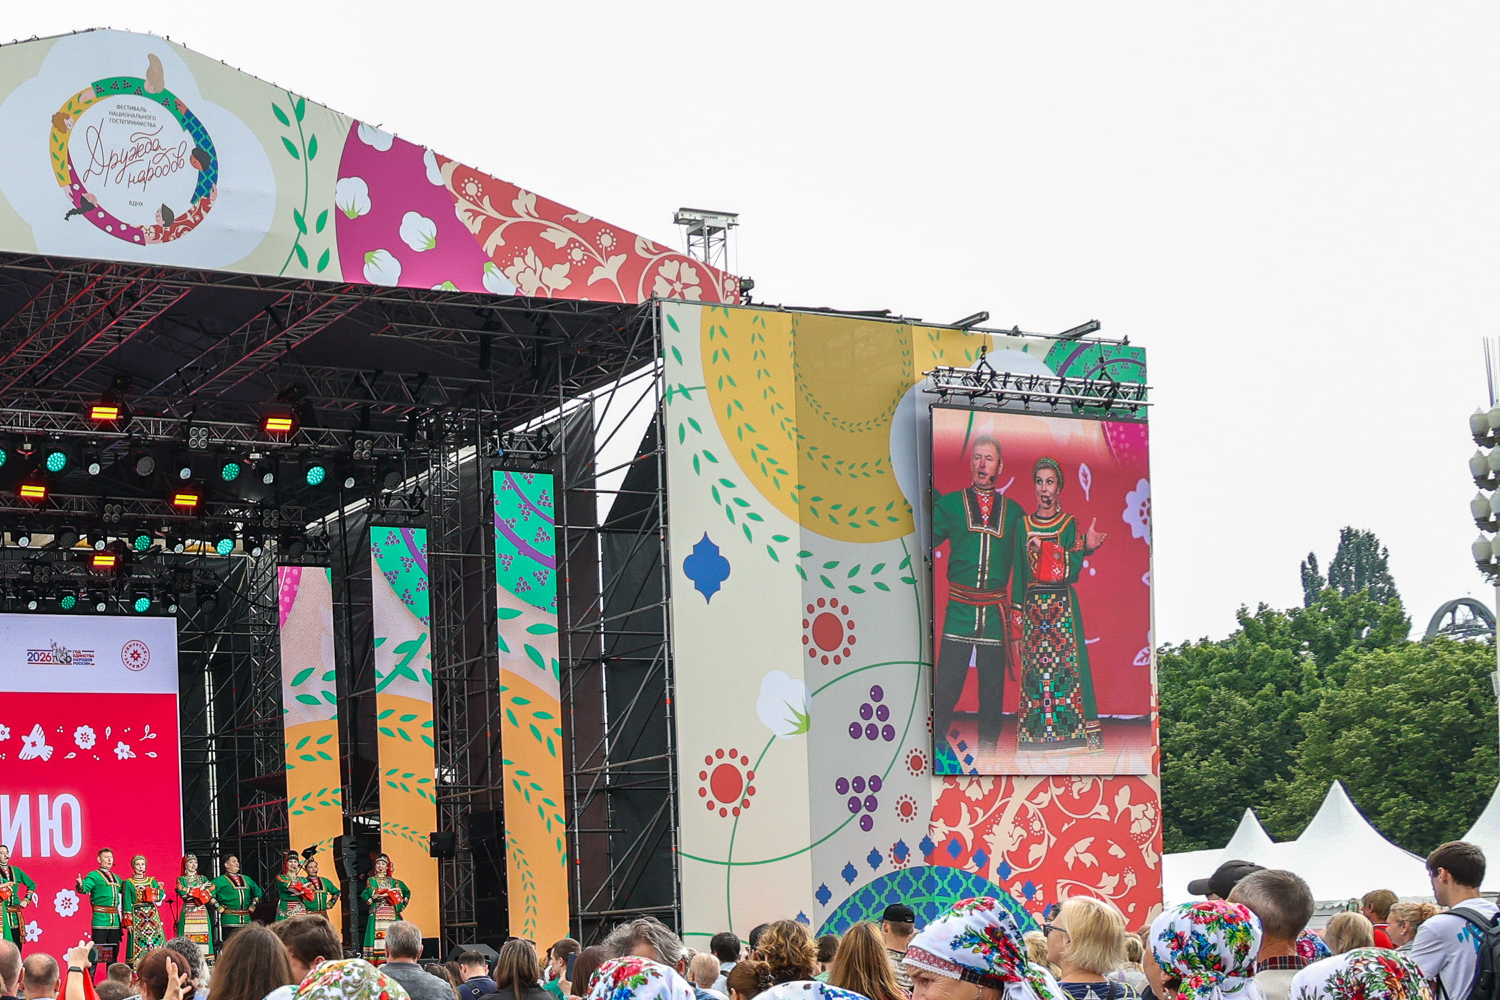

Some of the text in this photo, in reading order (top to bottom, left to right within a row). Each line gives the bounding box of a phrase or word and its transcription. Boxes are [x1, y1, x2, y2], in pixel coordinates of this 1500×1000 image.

[116, 104, 147, 113] ФЕСТИВАЛЬ
[108, 110, 157, 121] НАЦИОНАЛЬНОГО
[108, 118, 157, 128] ГОСТЕПРИИМСТВА
[83, 118, 166, 188] Дружба
[127, 140, 188, 192] народов
[26, 651, 52, 662] 2026
